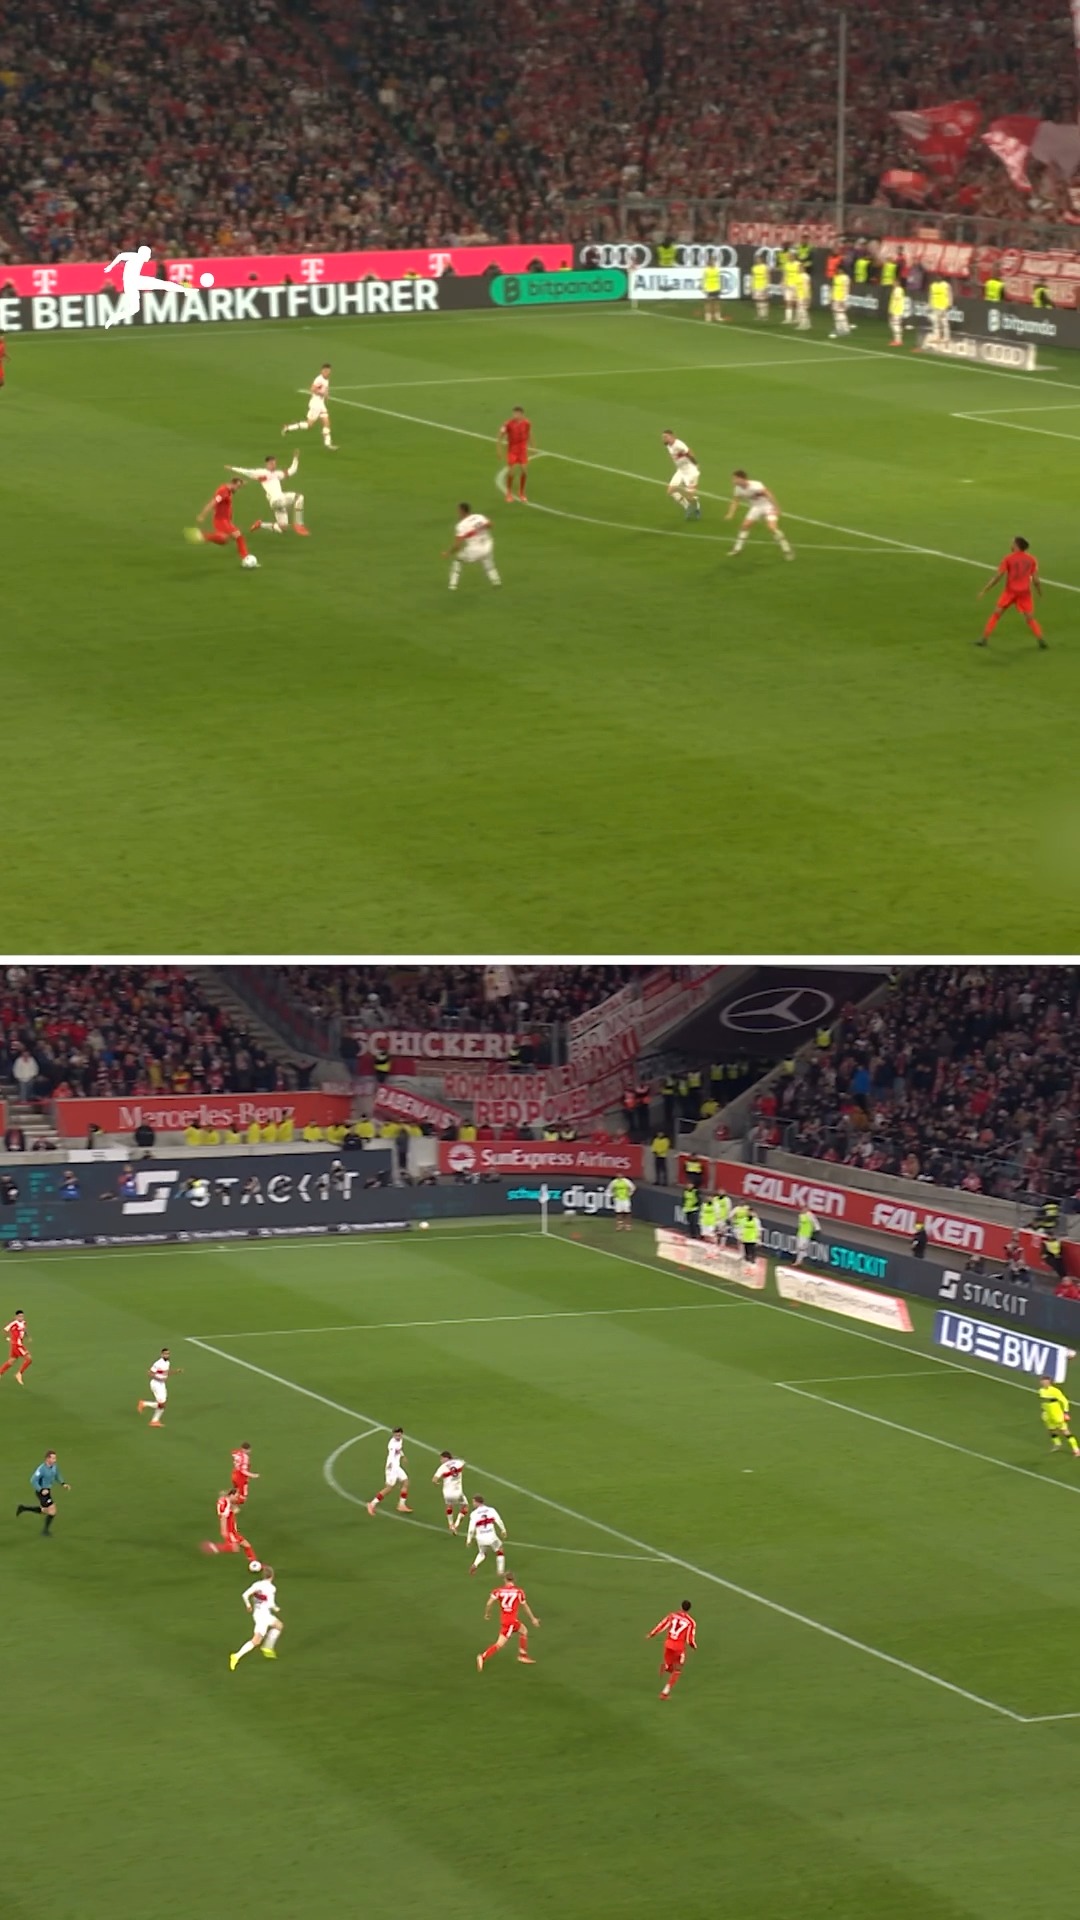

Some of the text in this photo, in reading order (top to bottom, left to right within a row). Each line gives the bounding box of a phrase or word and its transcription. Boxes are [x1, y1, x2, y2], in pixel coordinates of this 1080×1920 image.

[32, 293, 133, 330] BEIM
[118, 1102, 296, 1130] Mercedes-Benz
[480, 1148, 632, 1170] SunExpress Airlines
[742, 1172, 847, 1217] FALKEN
[871, 1203, 985, 1251] FALKEN
